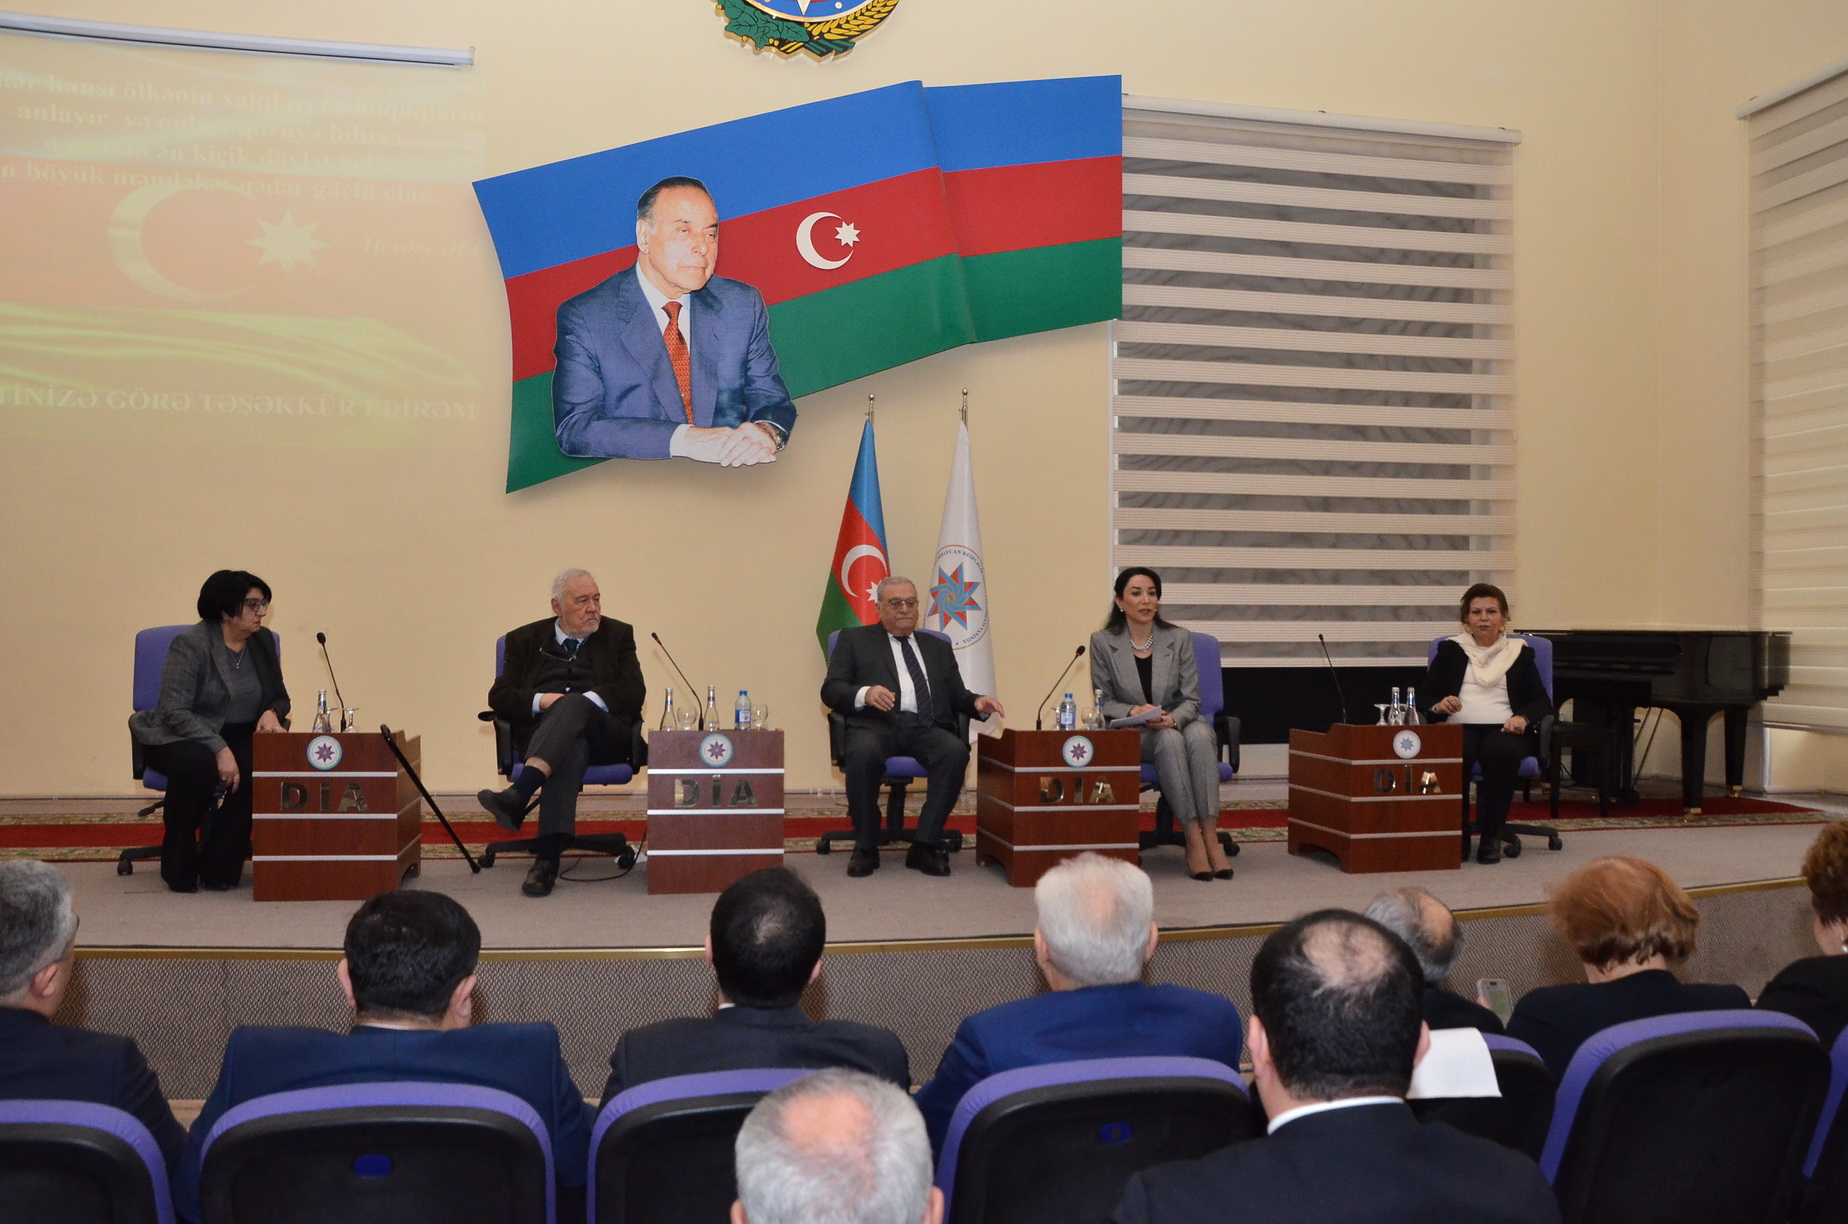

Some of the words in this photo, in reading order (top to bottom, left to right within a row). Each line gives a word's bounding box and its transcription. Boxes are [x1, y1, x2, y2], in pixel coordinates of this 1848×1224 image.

[123, 81, 214, 105] ölkənin
[17, 103, 110, 128] anlayır
[124, 114, 151, 129] və
[26, 160, 106, 187] böyük
[240, 177, 308, 199] qədər
[312, 181, 376, 202] güclü
[106, 386, 192, 412] GÖRƏ
[198, 393, 356, 418] TƏŞƏKKÜR
[674, 774, 758, 808] DİA
[1373, 764, 1442, 794] DİA
